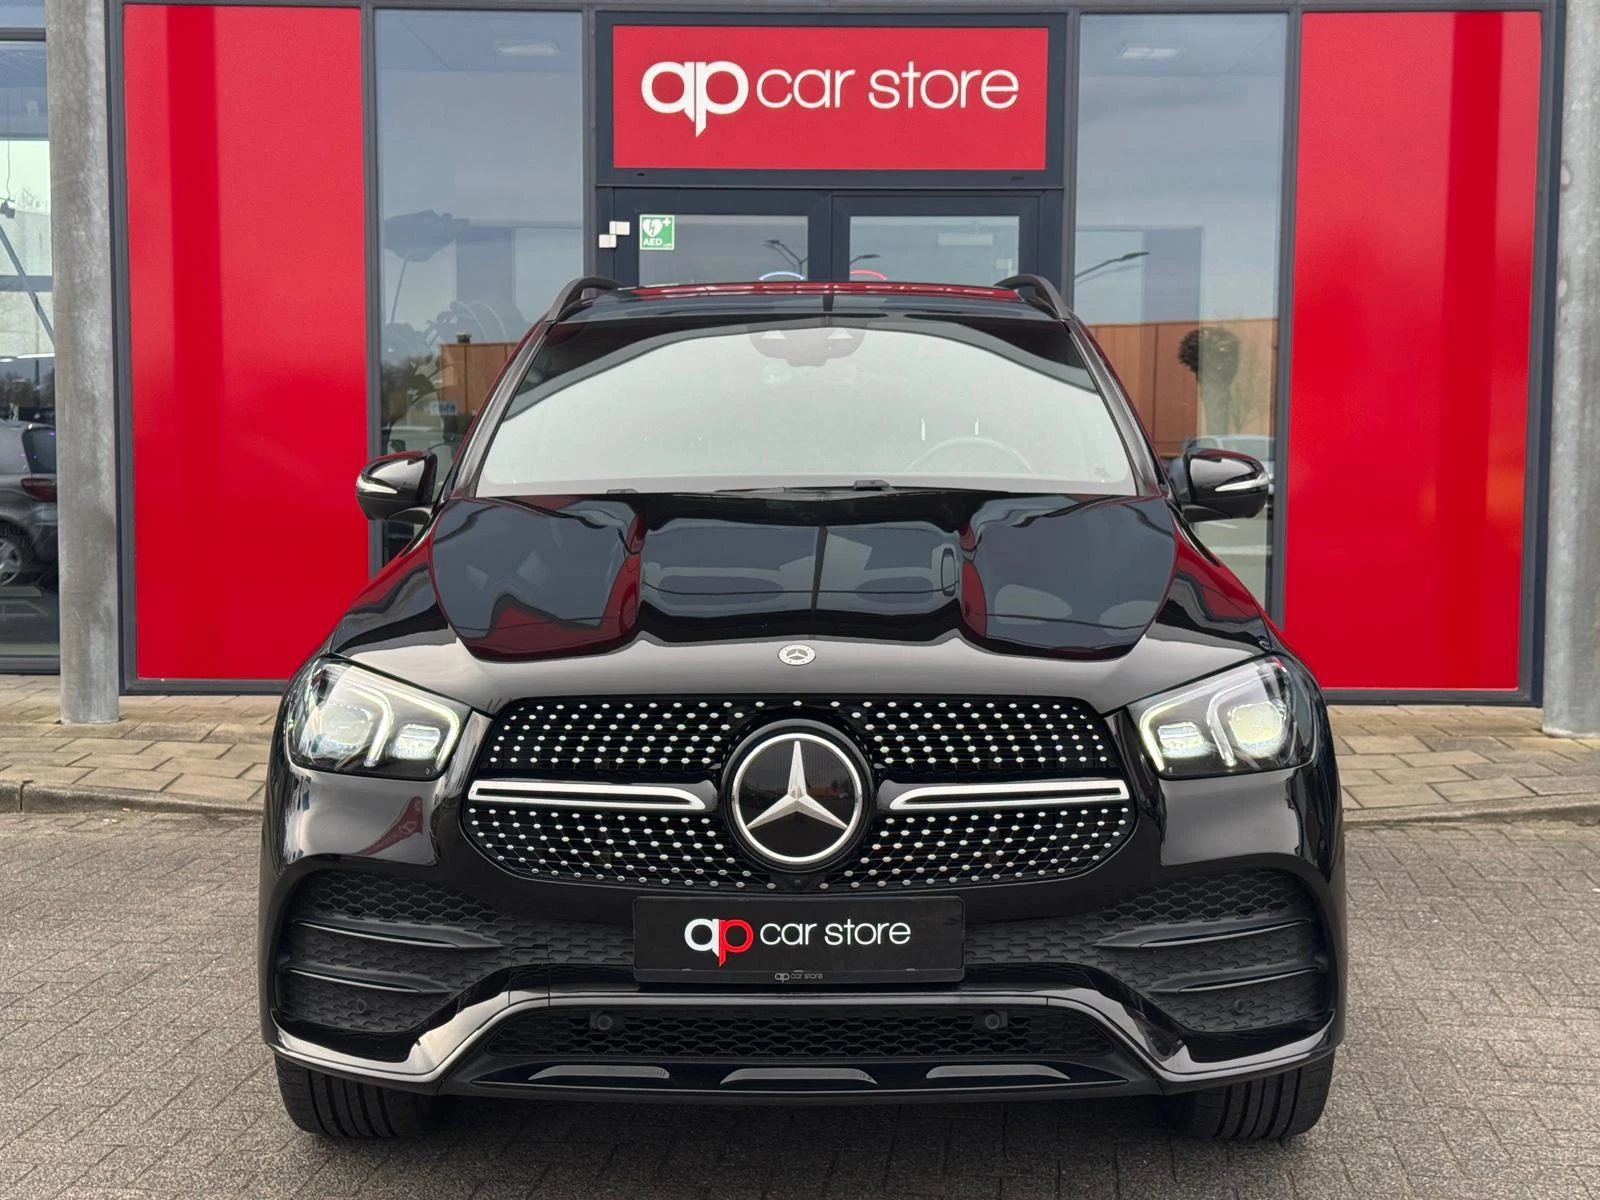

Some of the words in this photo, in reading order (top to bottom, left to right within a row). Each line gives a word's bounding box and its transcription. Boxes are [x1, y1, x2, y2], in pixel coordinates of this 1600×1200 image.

[757, 69, 855, 108] car
[869, 62, 1018, 108] store
[643, 238, 663, 246] AED
[760, 923, 817, 945] car
[824, 919, 911, 945] store
